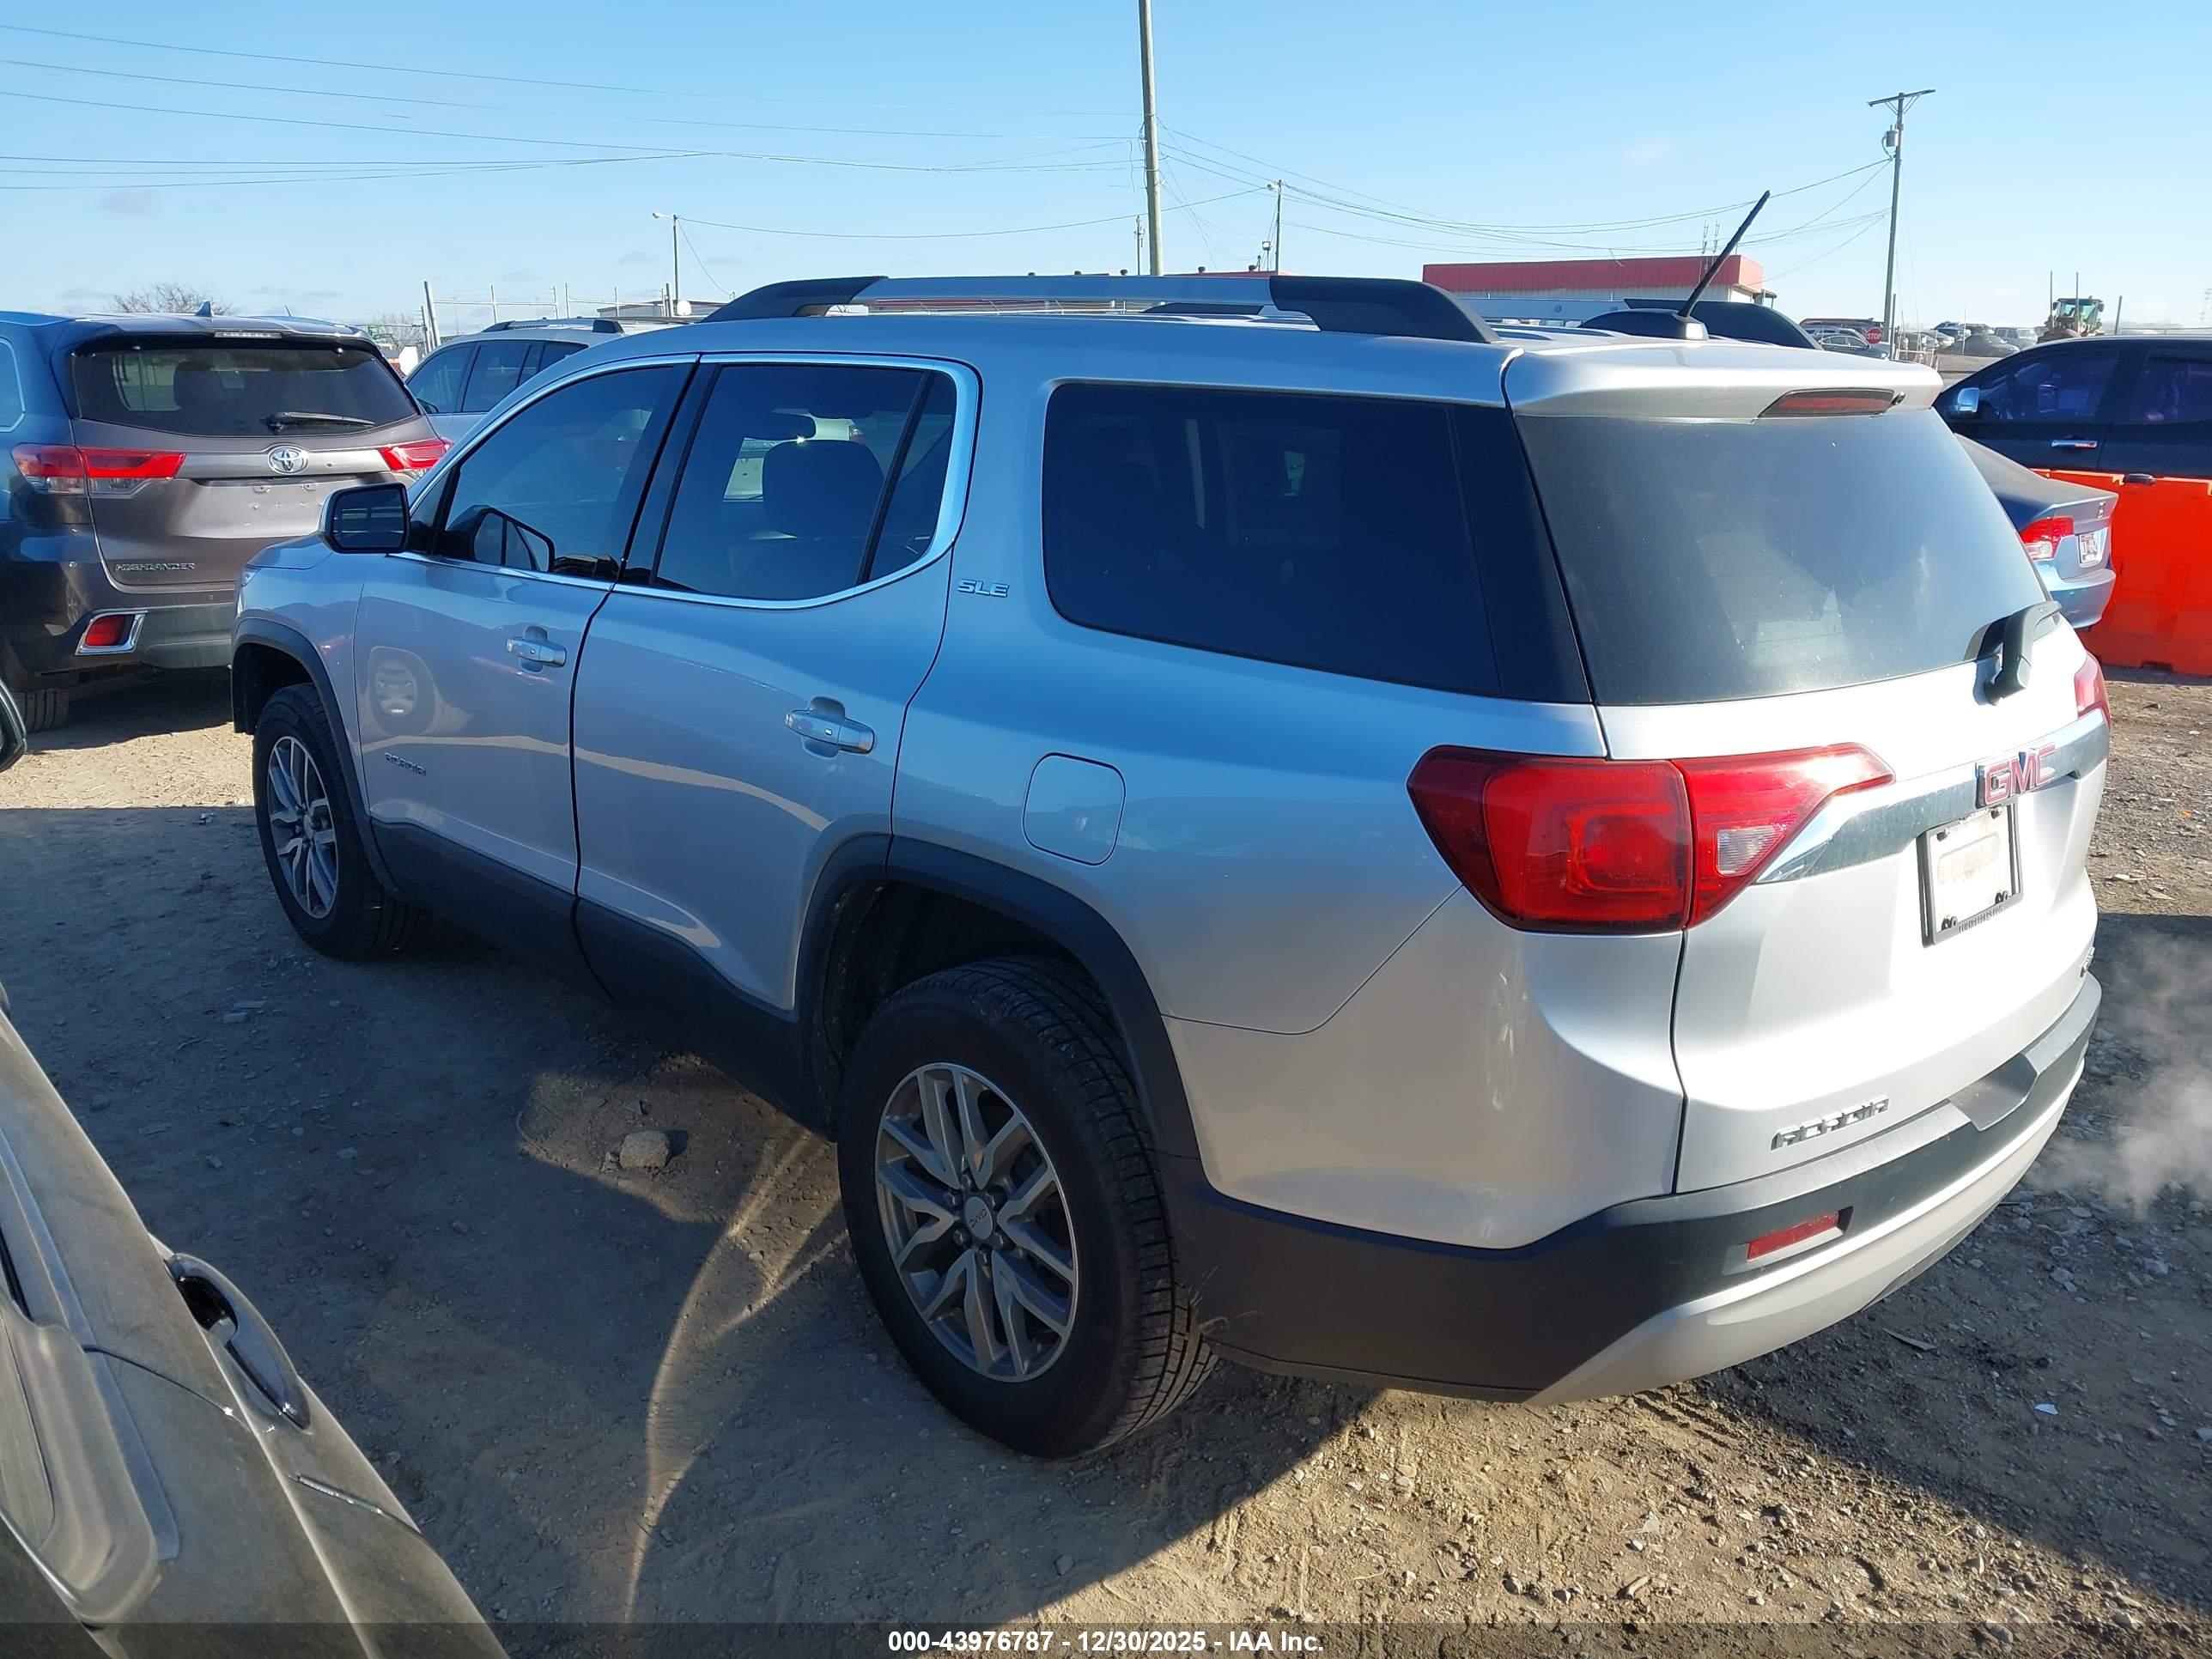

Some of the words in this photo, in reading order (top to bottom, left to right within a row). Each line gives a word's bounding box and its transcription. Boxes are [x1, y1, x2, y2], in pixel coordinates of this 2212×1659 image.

[115, 562, 196, 571] HIGHLANDER
[957, 579, 1010, 598] SLE
[1984, 742, 2057, 805] GMC
[1771, 1095, 1889, 1151] ACADIA
